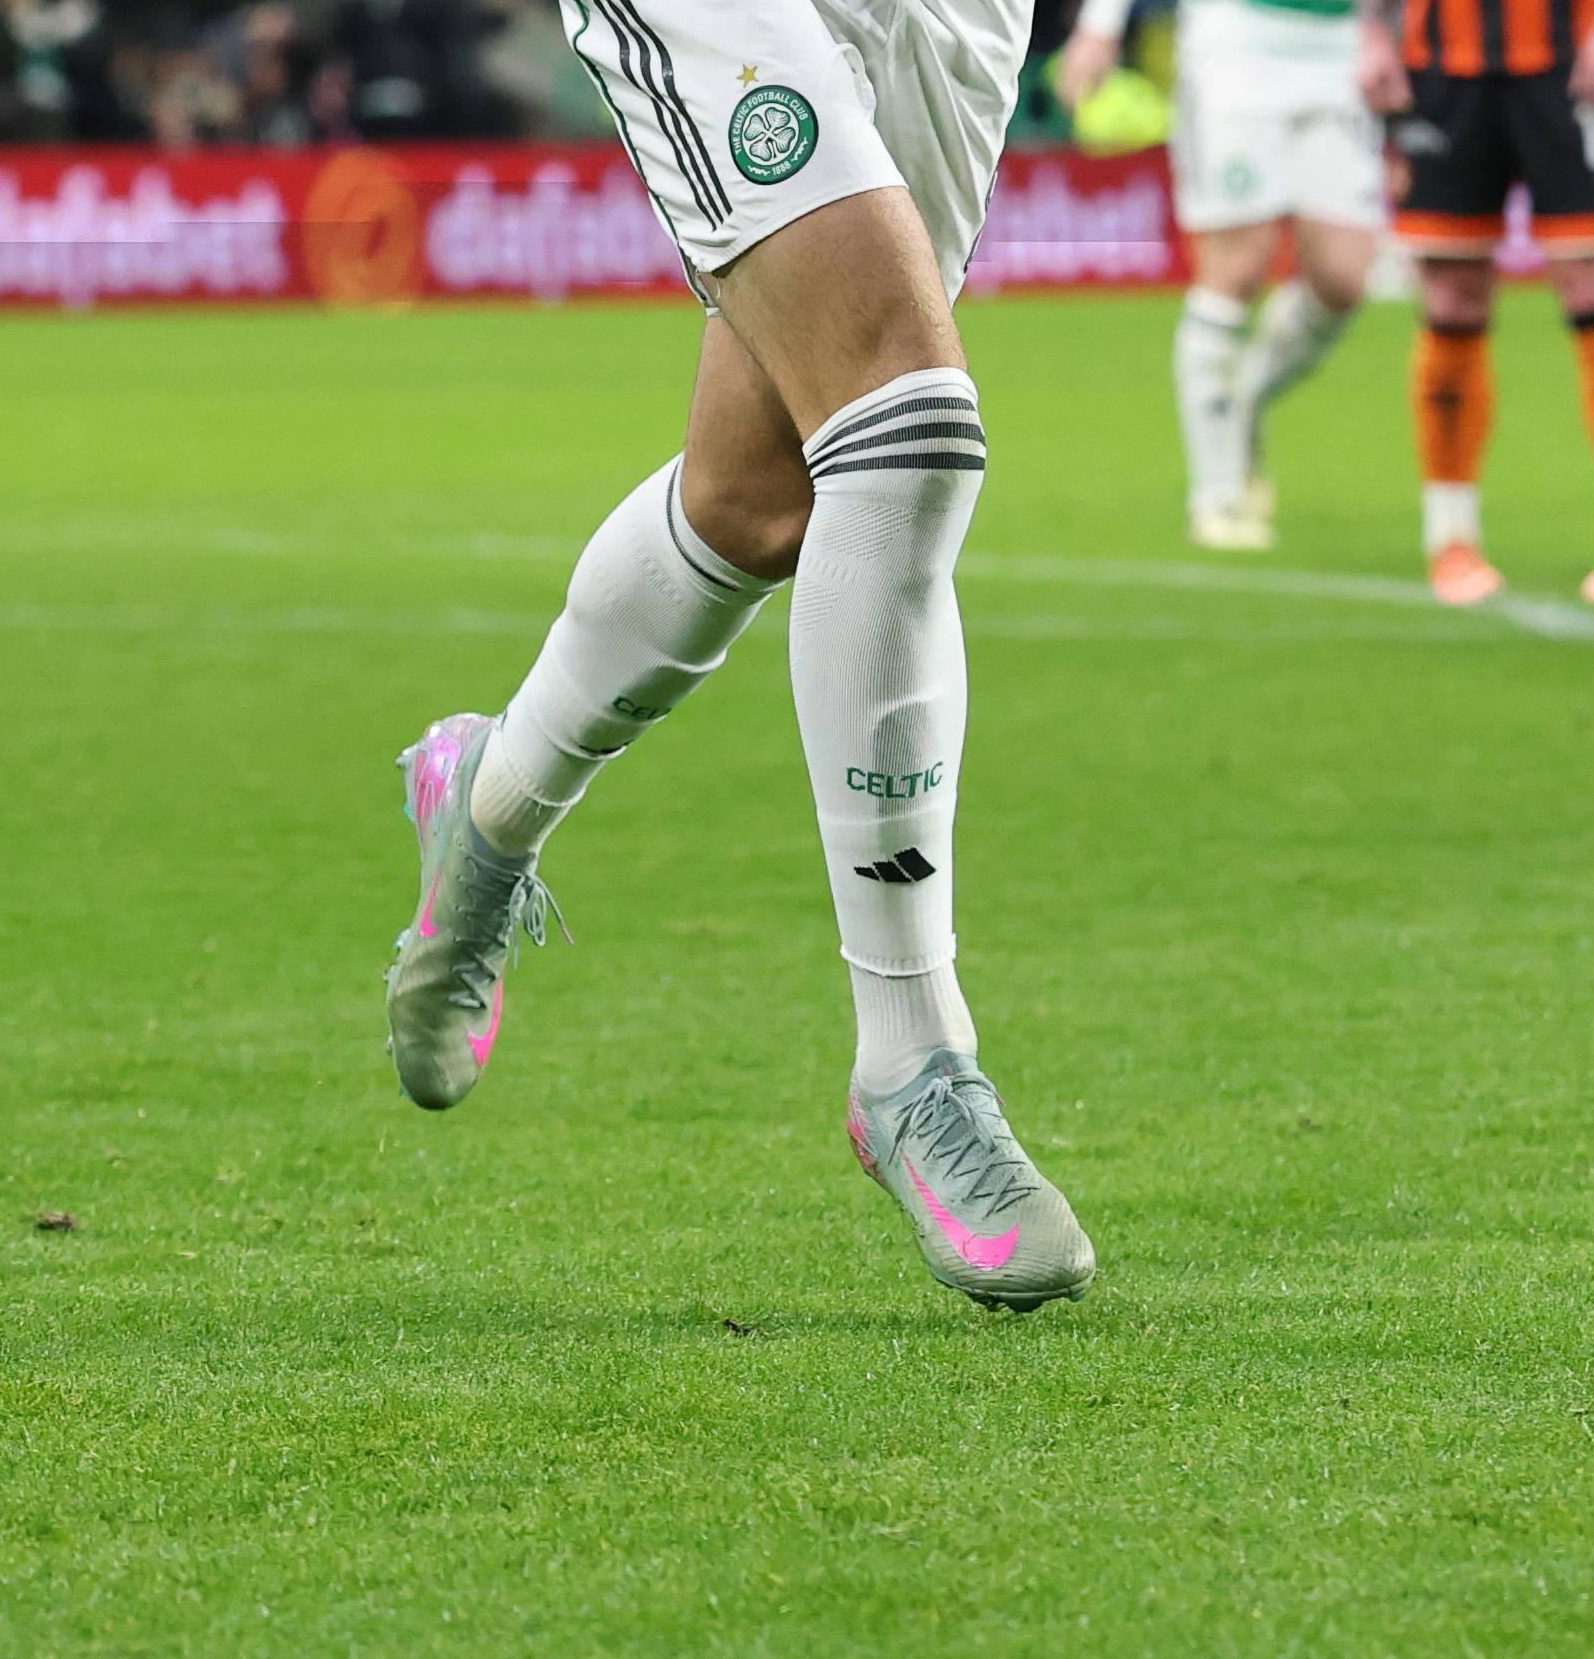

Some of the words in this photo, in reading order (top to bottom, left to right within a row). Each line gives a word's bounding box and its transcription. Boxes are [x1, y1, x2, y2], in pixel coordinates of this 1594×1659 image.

[747, 91, 789, 109] FOOTBALL
[789, 99, 809, 120] CLUB
[732, 105, 750, 135] CELTIC
[732, 137, 742, 155] THE
[845, 761, 944, 799] CELTIC
